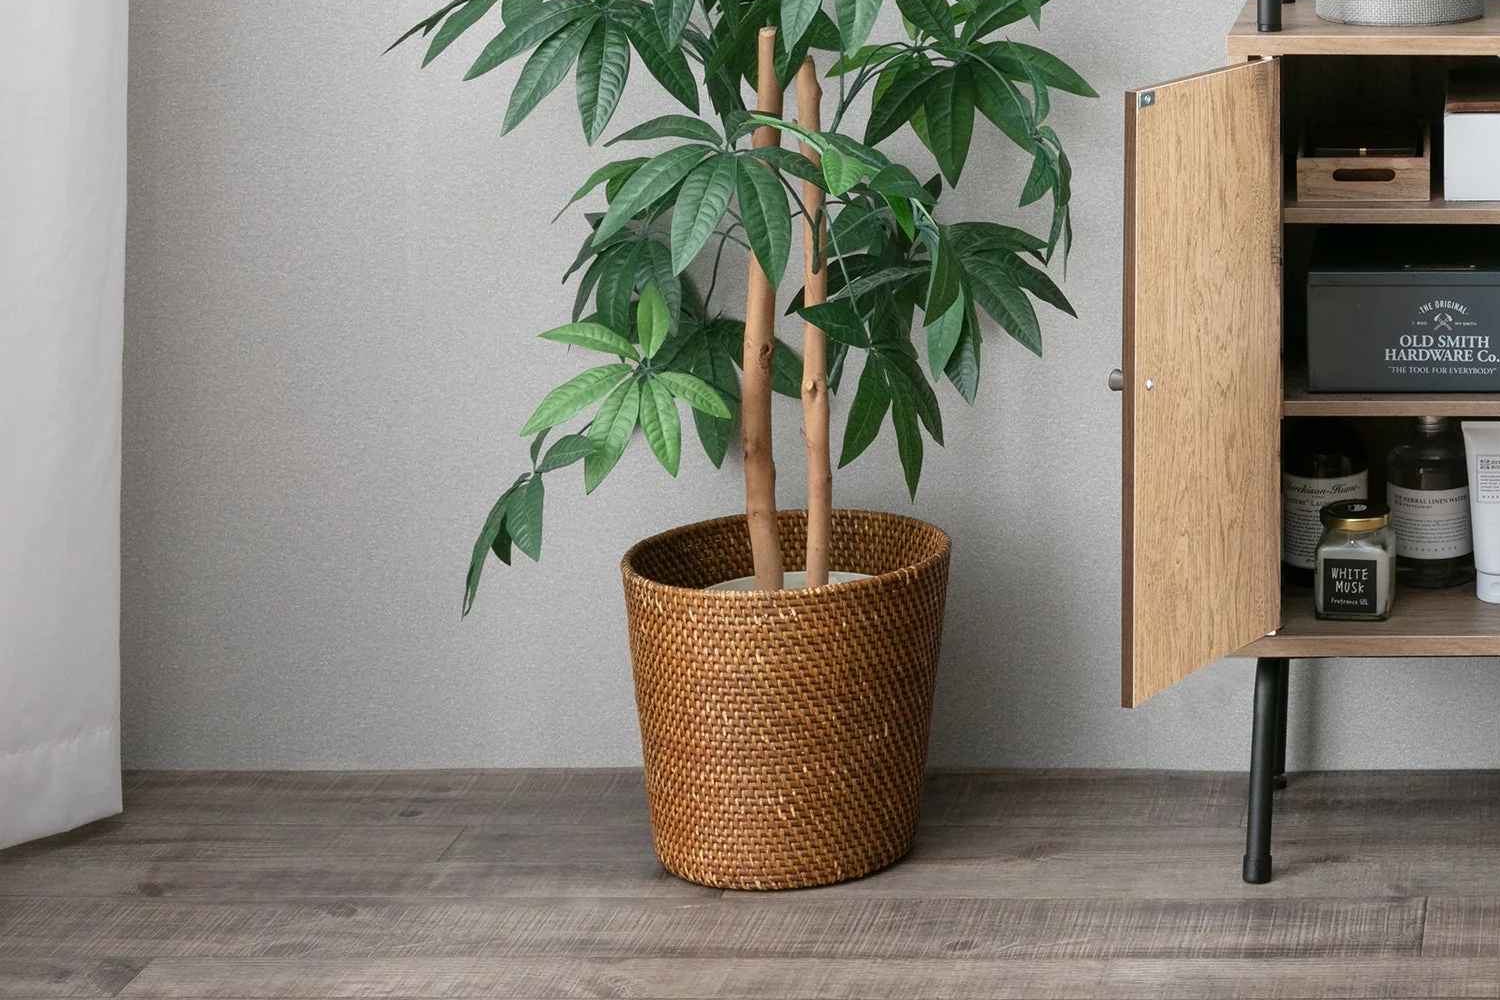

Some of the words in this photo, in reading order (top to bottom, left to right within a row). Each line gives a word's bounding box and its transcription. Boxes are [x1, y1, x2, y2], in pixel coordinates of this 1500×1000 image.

[1399, 334, 1434, 348] OLD
[1437, 334, 1490, 349] SMITH
[1384, 348, 1474, 362] HARDWARE
[1403, 496, 1427, 505] HERBAL
[1331, 567, 1369, 580] WHITE
